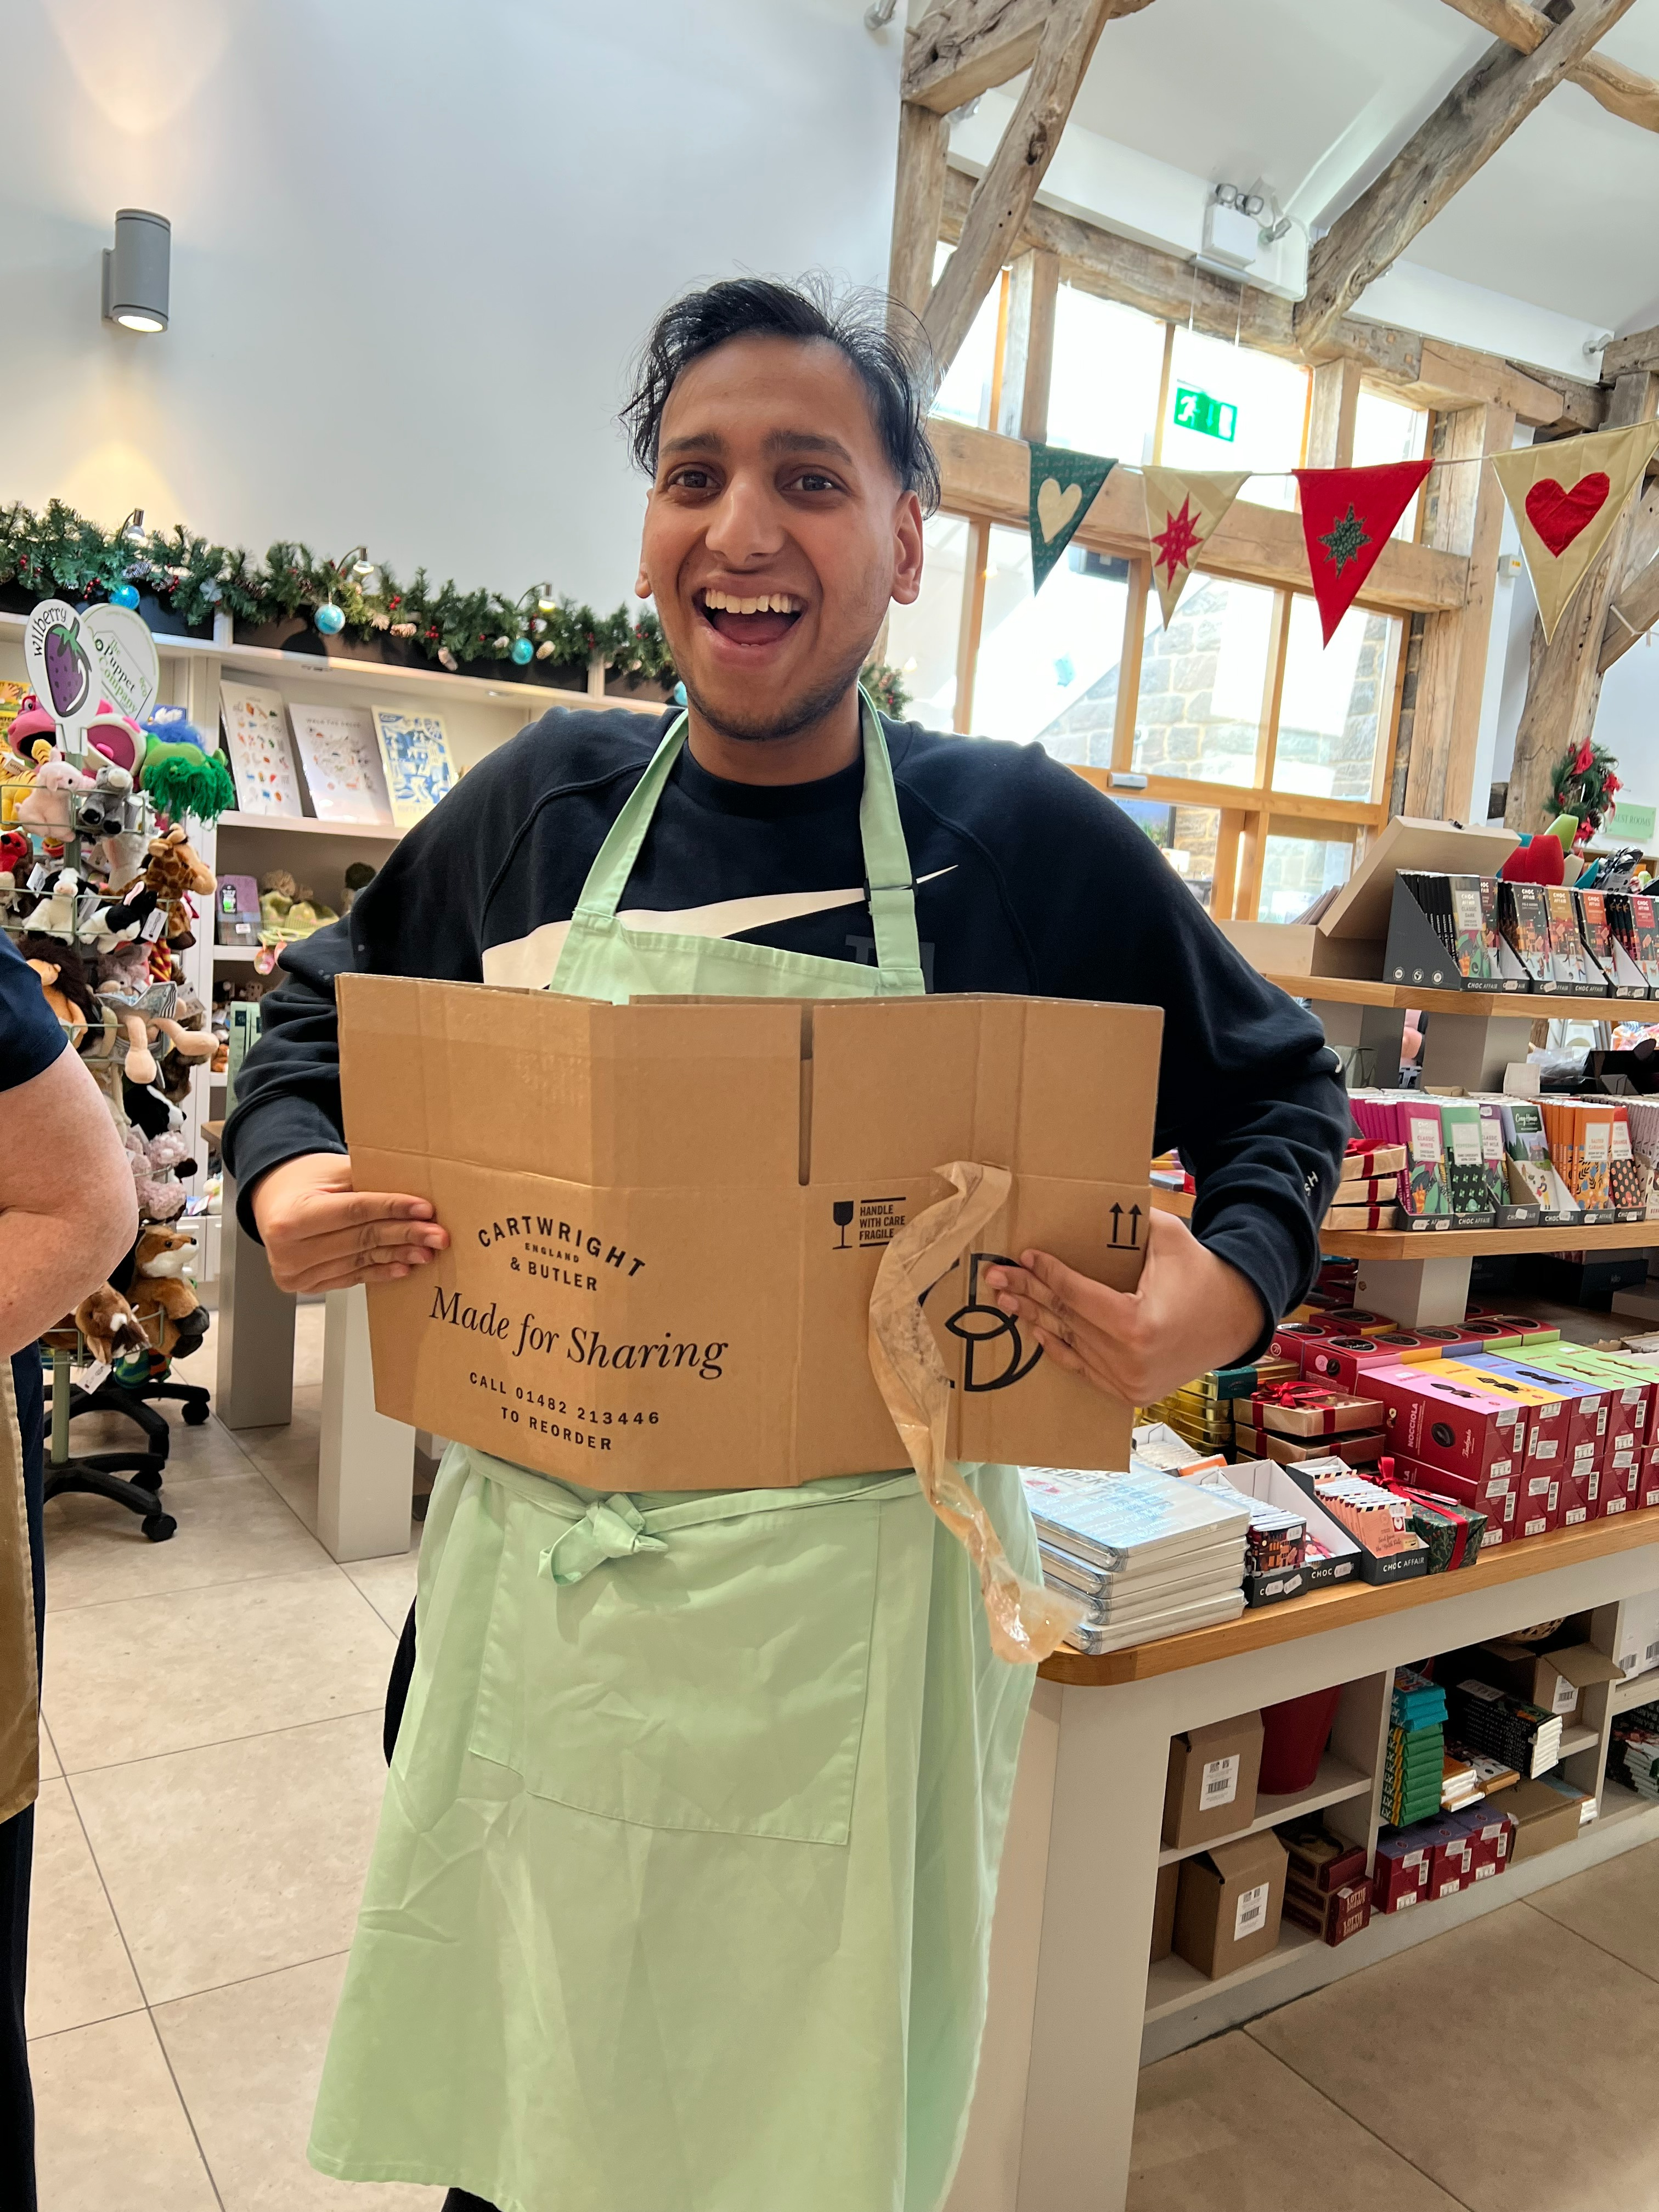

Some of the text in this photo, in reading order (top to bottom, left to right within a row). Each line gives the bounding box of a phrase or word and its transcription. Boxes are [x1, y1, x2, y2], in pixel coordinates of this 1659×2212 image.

[33, 607, 67, 656] wilberry
[99, 657, 137, 713] Company
[104, 645, 136, 694] Puppet
[1629, 815, 1651, 827] ROOMS
[859, 1215, 906, 1228] WITH CARE
[860, 1204, 894, 1216] HANDLE
[478, 1215, 646, 1278] CARTWRIGHT
[524, 1242, 580, 1263] ENGLAND
[859, 1228, 895, 1240] FRAGILE
[510, 1257, 598, 1291] & BUTLER
[428, 1285, 729, 1380] Made for Sharing
[470, 1372, 660, 1426] CALL 01482 213446
[500, 1406, 612, 1451] TO REORDER
[1407, 1403, 1419, 1448] NOCCIOLA
[1311, 1567, 1333, 1579] CHOC
[1383, 1556, 1425, 1573] CHOC AFFAIR
